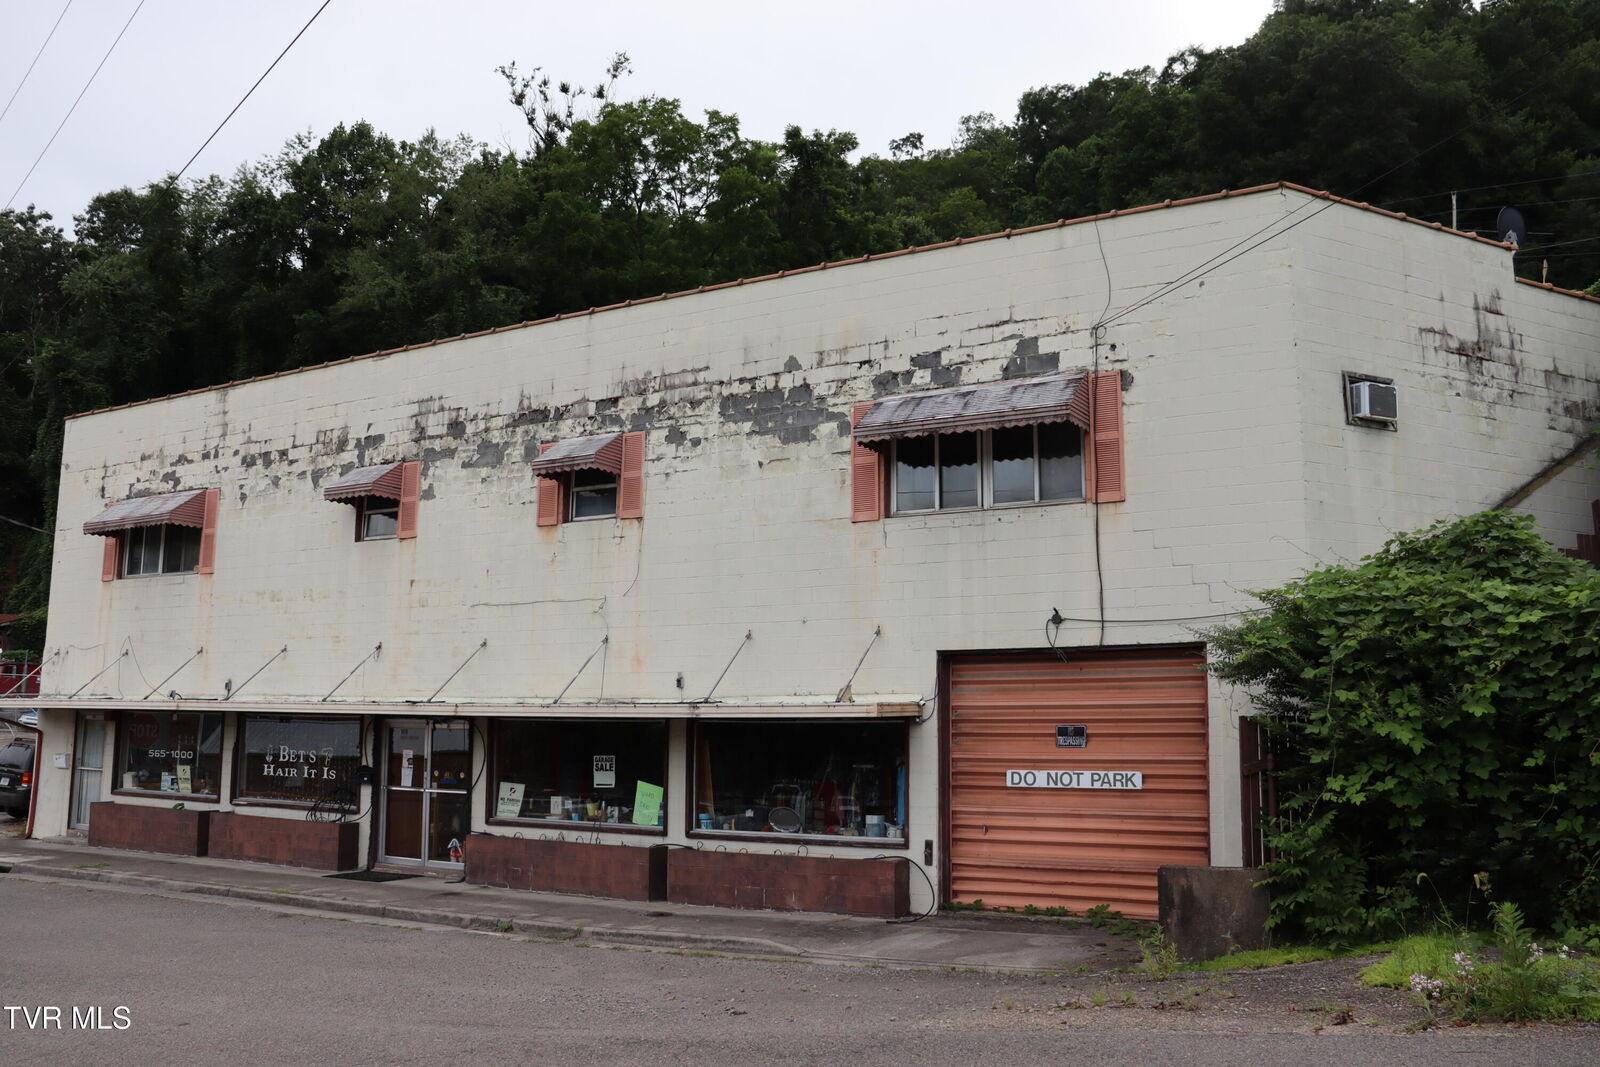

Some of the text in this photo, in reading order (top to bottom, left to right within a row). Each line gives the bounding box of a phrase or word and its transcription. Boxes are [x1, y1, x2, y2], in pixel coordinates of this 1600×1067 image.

[148, 749, 194, 760] 565-1000
[279, 745, 317, 763] BET'S
[595, 762, 614, 772] SALE
[1010, 771, 1137, 788] DO NOT PARK
